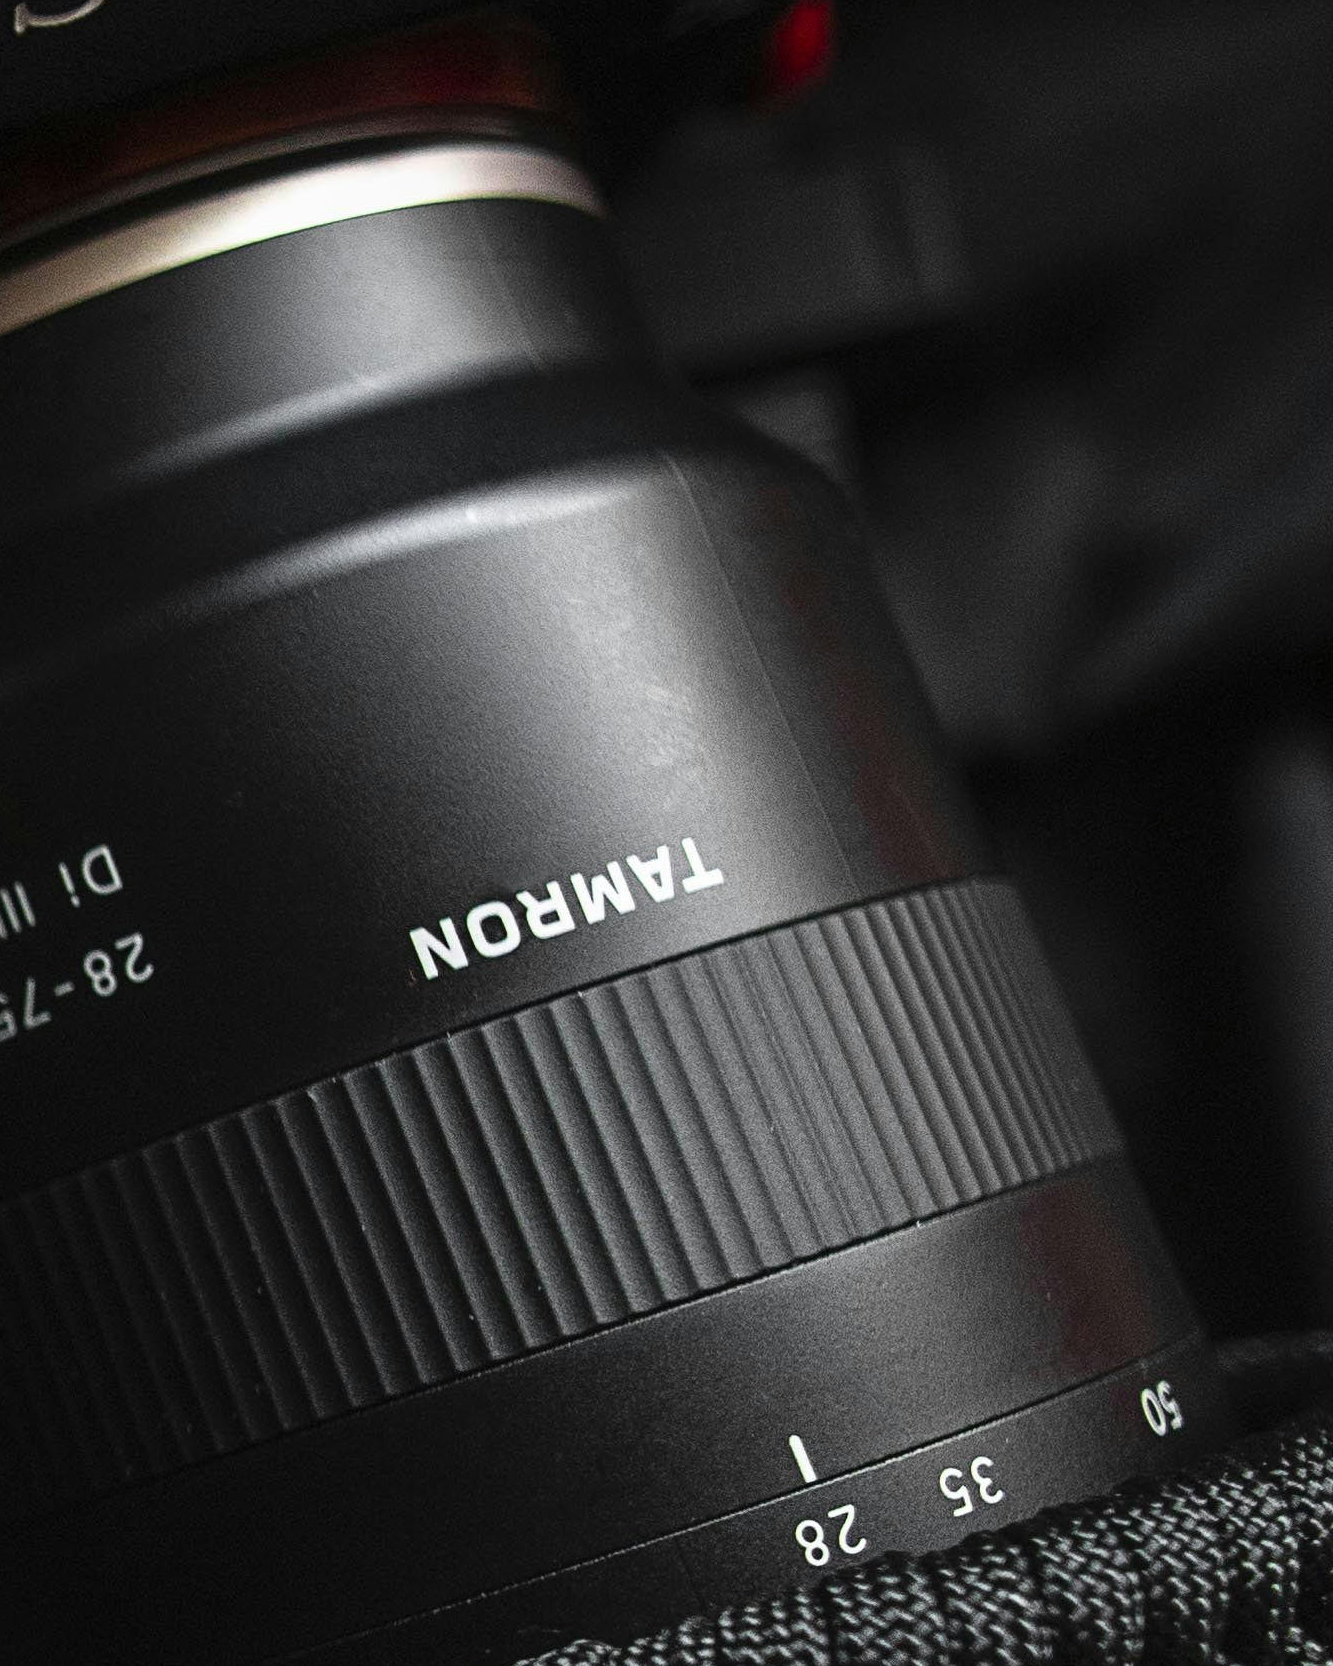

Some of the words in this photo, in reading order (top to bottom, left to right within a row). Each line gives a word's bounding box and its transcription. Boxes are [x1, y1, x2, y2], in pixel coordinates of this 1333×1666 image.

[59, 844, 124, 908] Di
[409, 837, 724, 980] TAMRON
[1140, 1380, 1183, 1437] 50
[939, 1456, 1005, 1517] 35
[795, 1503, 867, 1567] 28
